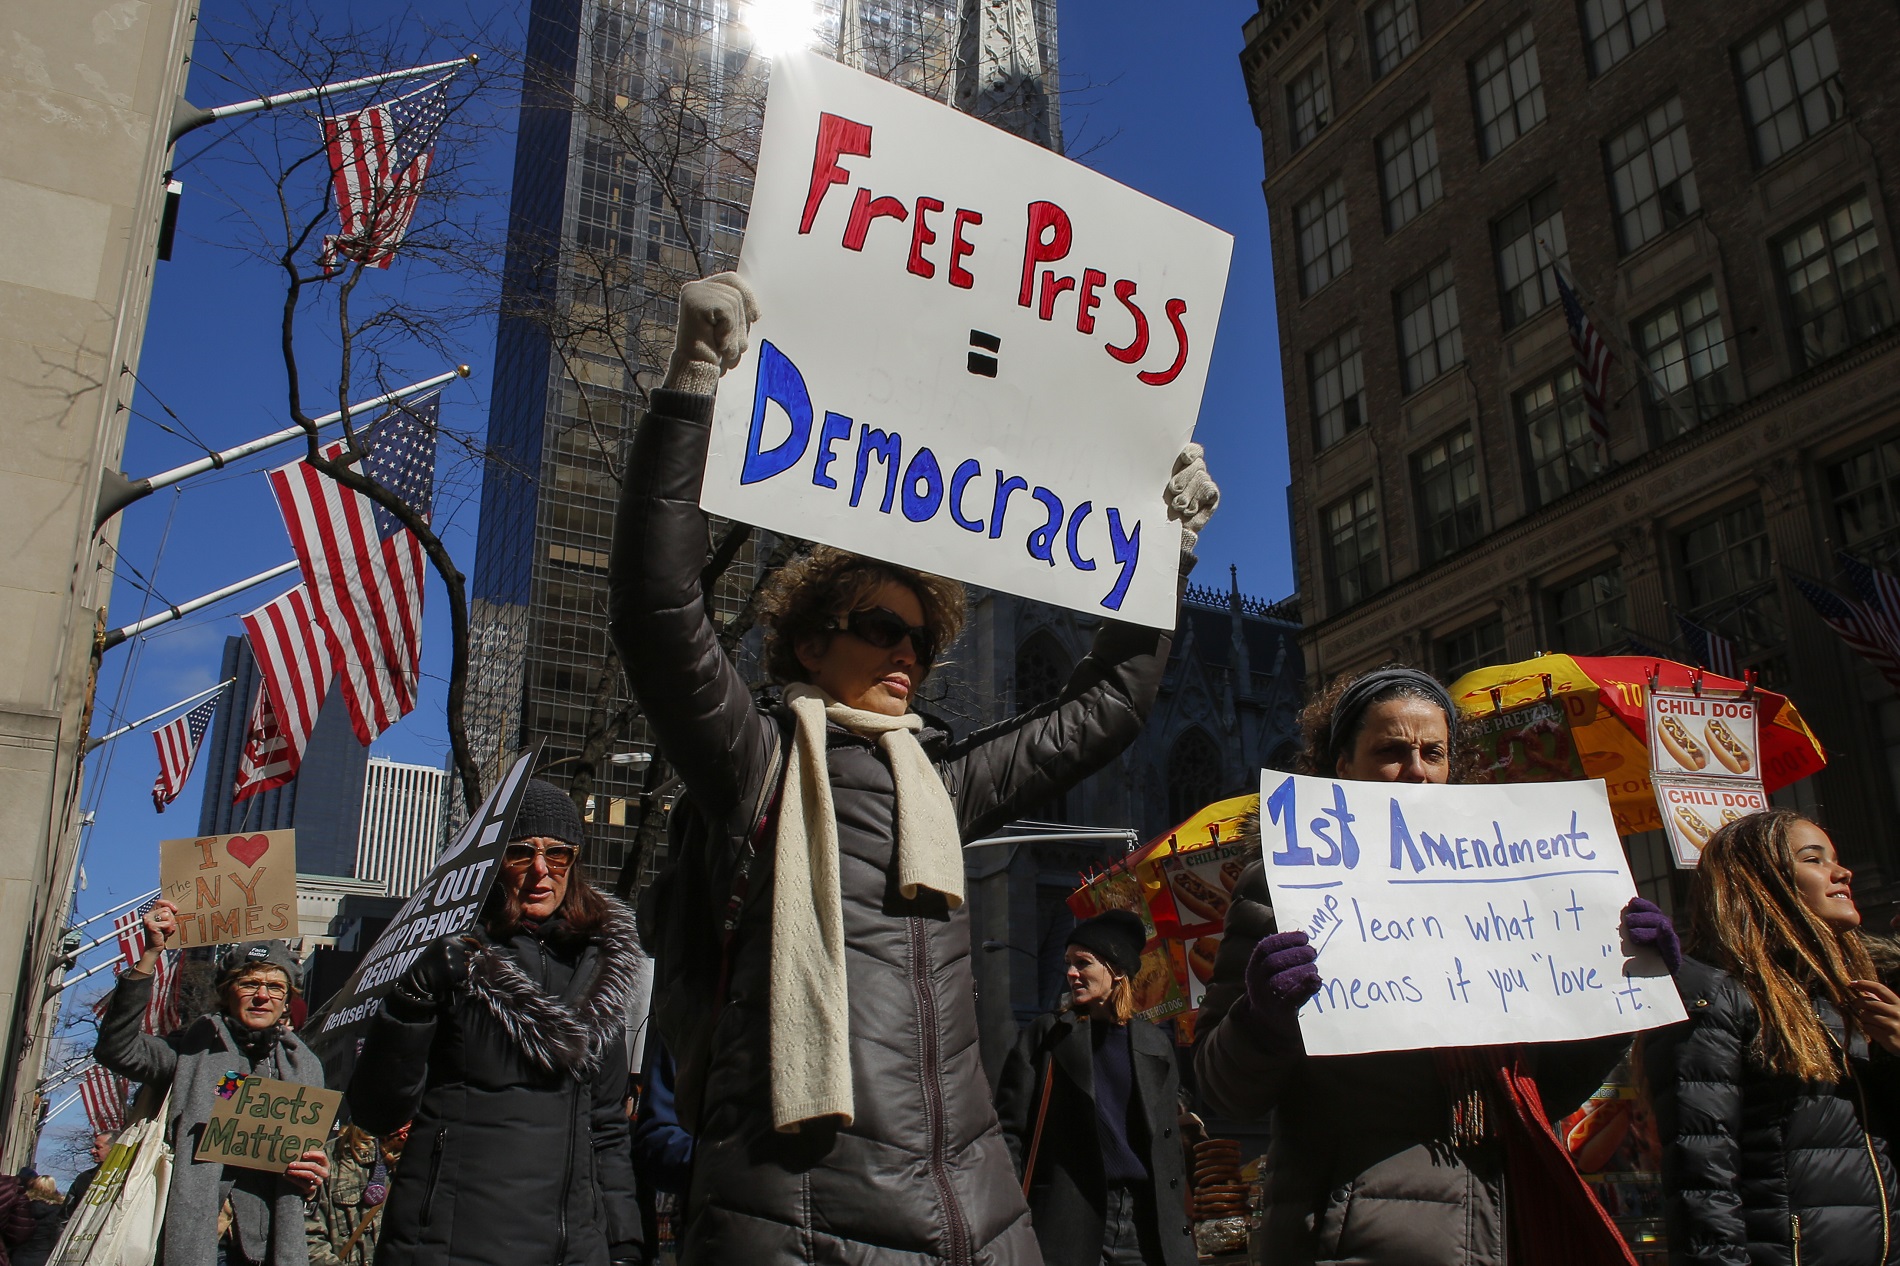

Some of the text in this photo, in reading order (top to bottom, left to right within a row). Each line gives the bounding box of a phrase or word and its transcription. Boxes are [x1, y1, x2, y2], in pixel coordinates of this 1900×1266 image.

[1656, 699, 1752, 719] CHILI DOG
[1667, 790, 1761, 809] CHILI DOG
[1266, 776, 1361, 870] 1st
[194, 837, 218, 870] I
[1186, 849, 1220, 867] CHILI
[166, 880, 191, 898] The
[433, 859, 495, 907] OUT
[174, 903, 290, 946] TIMES
[1303, 889, 1585, 943] ump learn what it
[1168, 997, 1183, 1011] DOG
[1311, 974, 1423, 1014] means
[1445, 956, 1471, 1004] if
[1488, 967, 1529, 1013] you
[235, 1078, 324, 1125] Facts
[200, 1117, 323, 1164] Matter
